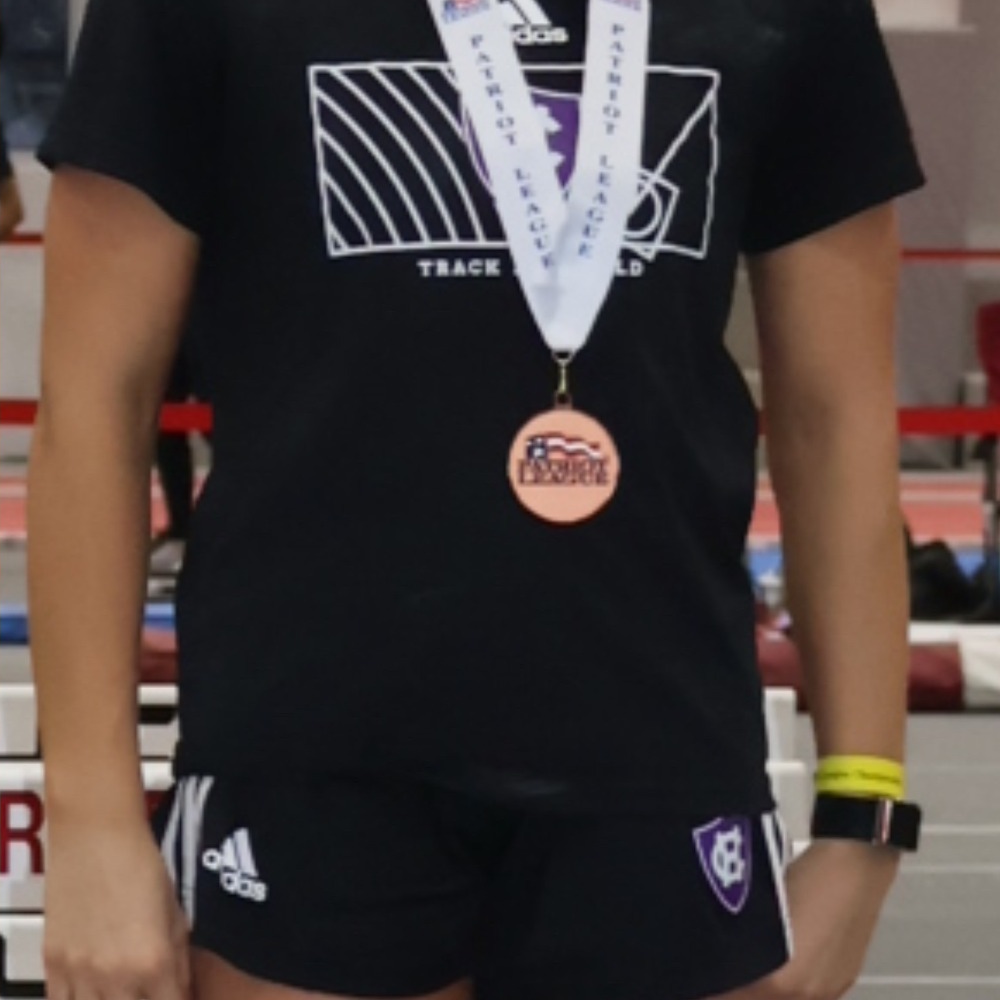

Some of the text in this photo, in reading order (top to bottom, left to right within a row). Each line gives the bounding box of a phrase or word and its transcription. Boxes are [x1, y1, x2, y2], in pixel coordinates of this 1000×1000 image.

[470, 35, 517, 146] PATRIOT
[602, 23, 626, 135] PATRIOT
[577, 155, 612, 259] LEAGUE
[416, 258, 501, 277] TRACK
